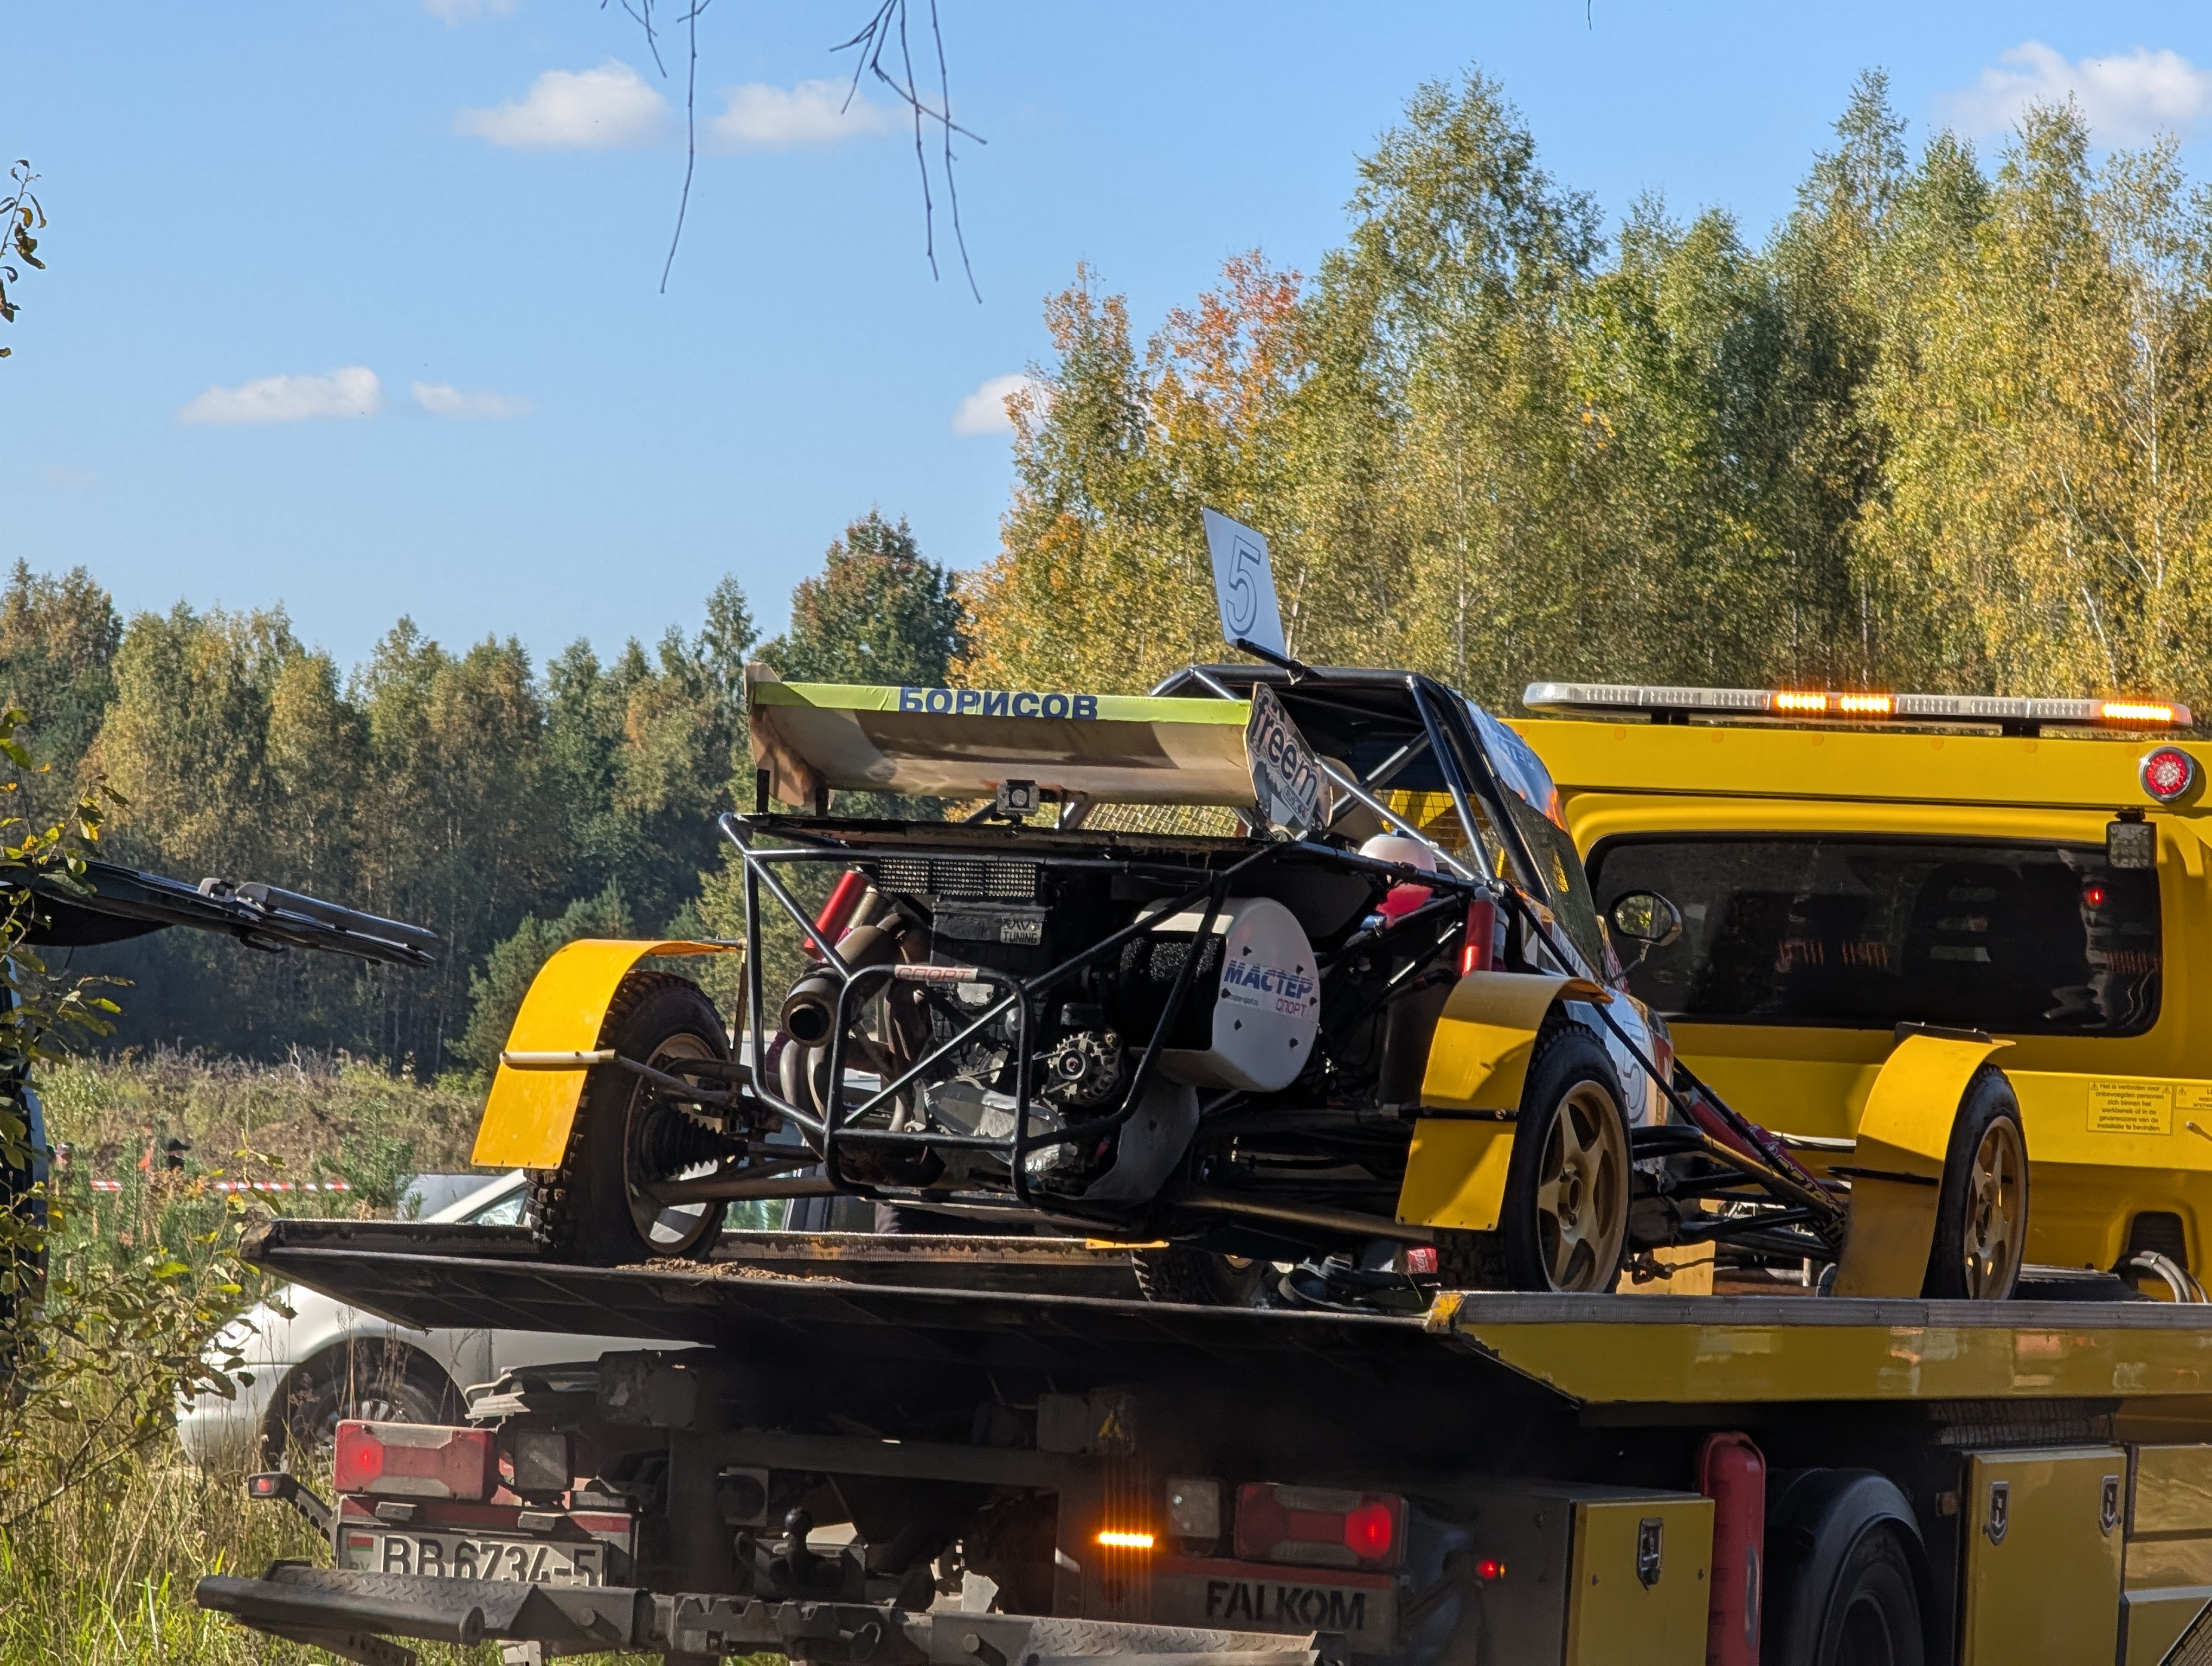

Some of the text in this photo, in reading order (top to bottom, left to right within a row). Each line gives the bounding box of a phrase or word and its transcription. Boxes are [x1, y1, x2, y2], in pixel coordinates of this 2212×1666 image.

[1226, 534, 1262, 636] 5
[899, 686, 1098, 720] БОРИСОВ
[1251, 695, 1318, 807] freem
[1004, 931, 1038, 944] TUNING
[897, 967, 971, 982] СПОРТ
[1223, 959, 1314, 999] МАСТЕР
[1276, 998, 1308, 1017] СПОРТ
[1206, 1580, 1366, 1630] FALKOM
